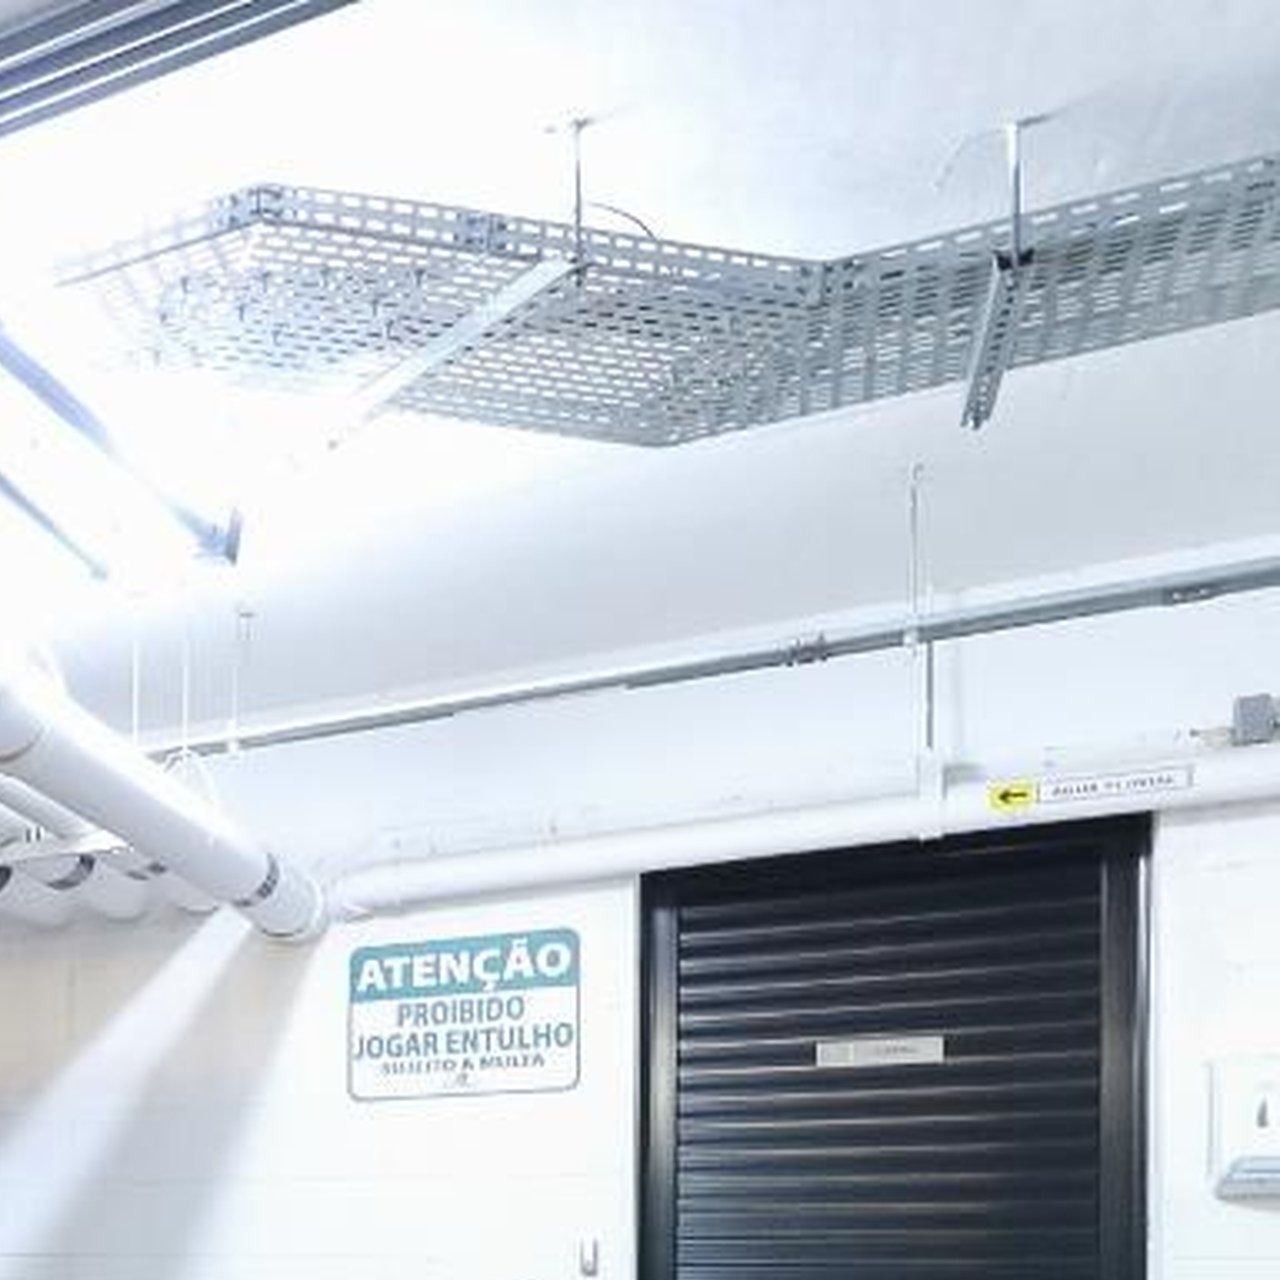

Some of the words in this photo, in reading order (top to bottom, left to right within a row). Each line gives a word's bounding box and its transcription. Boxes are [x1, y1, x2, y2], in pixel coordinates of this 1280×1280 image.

[356, 937, 571, 992] ATENÇÃO
[397, 996, 525, 1027] PROIBIDO
[354, 1030, 439, 1060] JOGAR
[446, 1022, 574, 1055] ENTULHO
